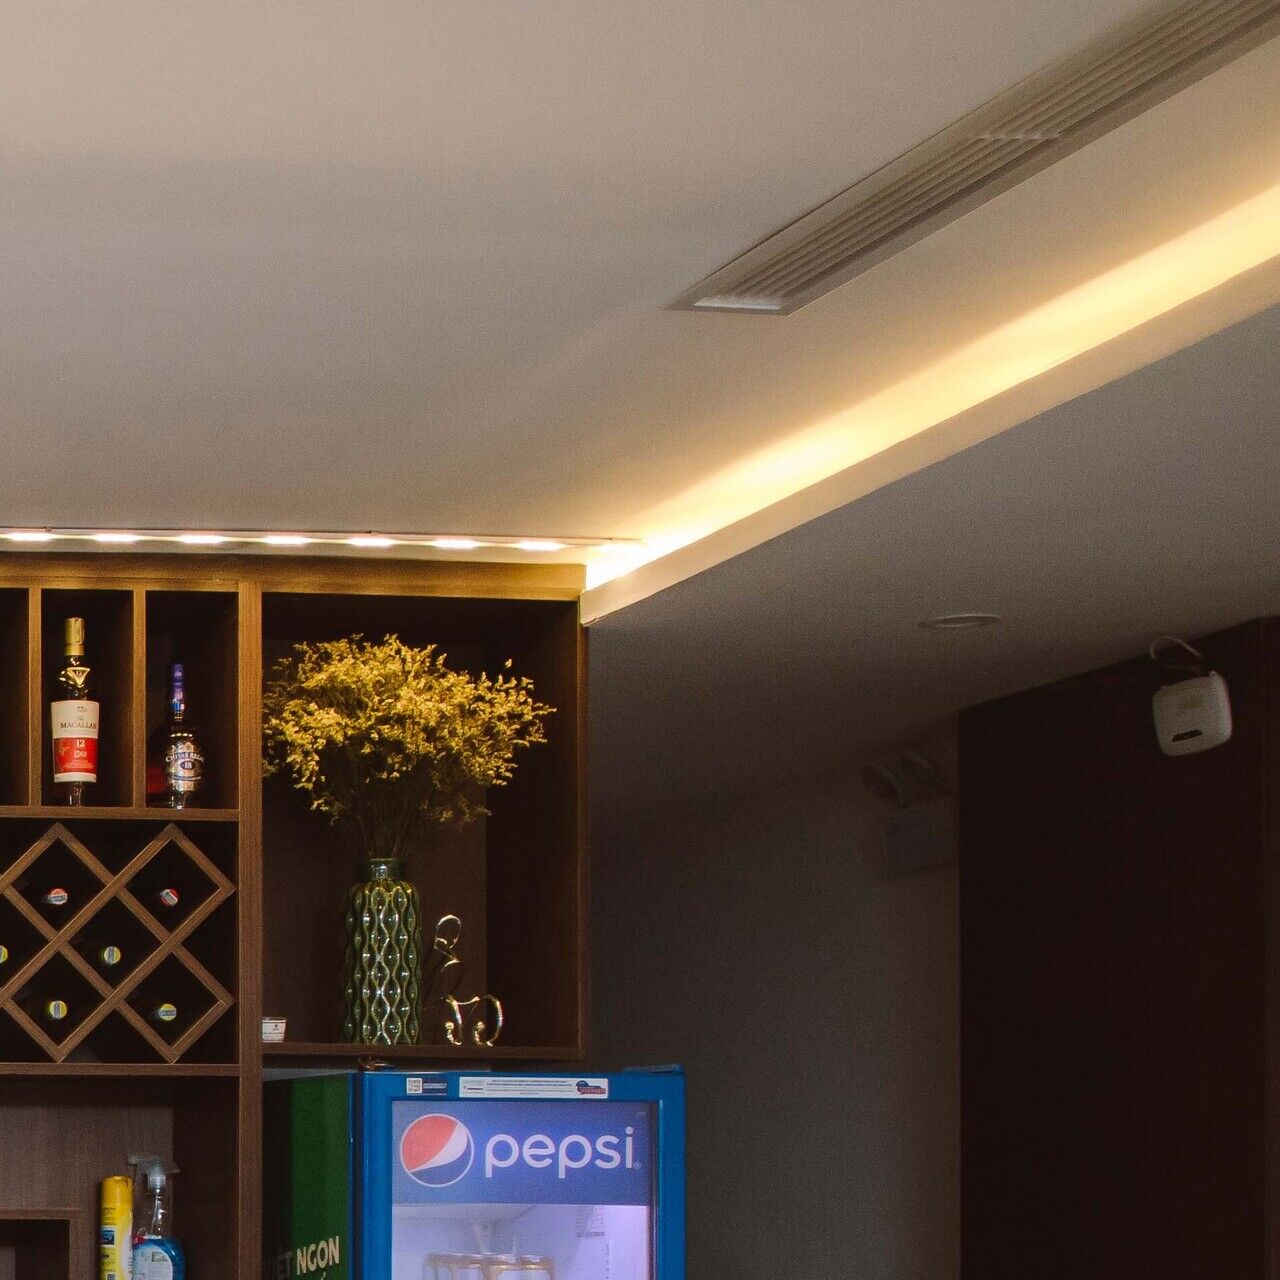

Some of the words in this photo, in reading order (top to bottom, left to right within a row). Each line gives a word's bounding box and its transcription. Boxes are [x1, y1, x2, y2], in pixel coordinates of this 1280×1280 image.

[76, 739, 85, 748] 12
[485, 1126, 634, 1179] pepsi
[296, 1235, 340, 1276] NGON
